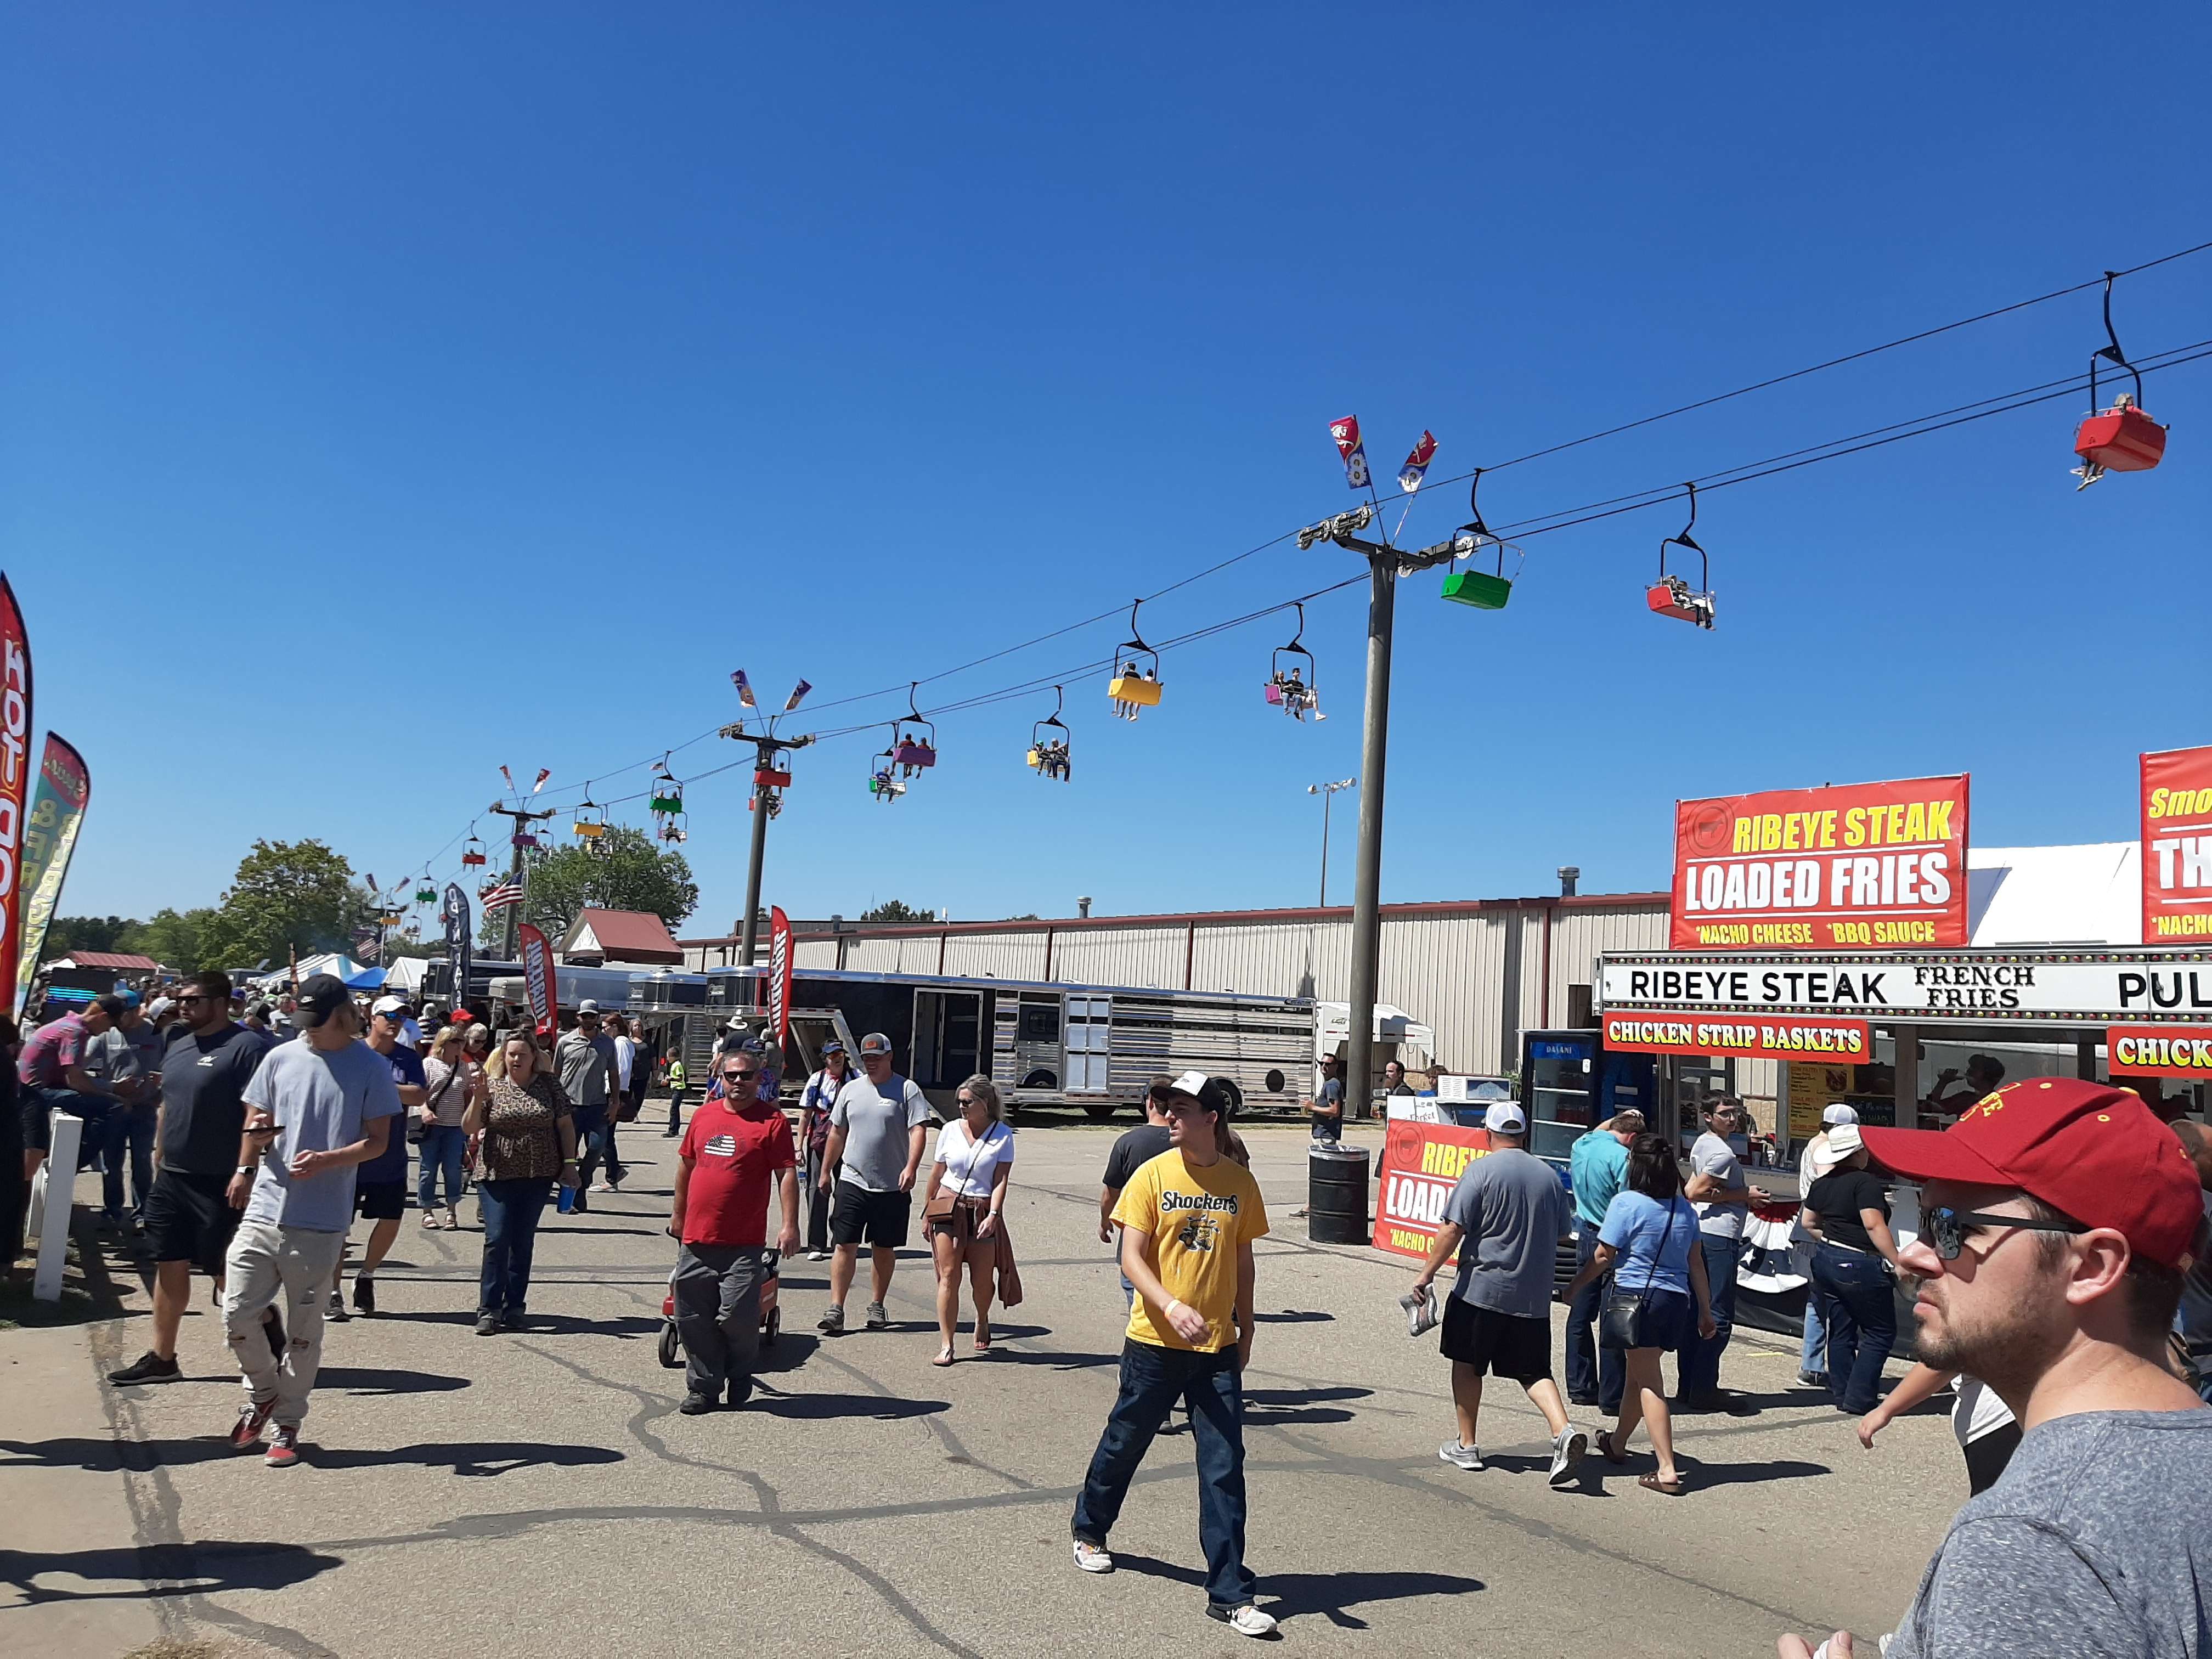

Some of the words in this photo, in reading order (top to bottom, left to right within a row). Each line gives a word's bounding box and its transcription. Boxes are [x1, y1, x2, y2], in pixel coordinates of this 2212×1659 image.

[1733, 810, 1838, 853] RIBEYE
[1845, 801, 1955, 845] STEAK
[1685, 861, 1820, 911] LOADED
[1831, 851, 1951, 906] FRIES
[1752, 923, 1814, 944] CHEESE
[1874, 921, 1936, 943] SAUCE
[1631, 971, 1749, 1002] RIBEYE
[1762, 973, 1888, 1004] STEAK
[1914, 967, 2035, 987] FRENCH
[1927, 988, 2019, 1008] FRIES
[1546, 1045, 1572, 1054] DASANI
[1608, 1020, 1692, 1045] CHICKEN
[1697, 1023, 1756, 1048] STRIP
[1761, 1026, 1863, 1053] BASKETS
[2116, 1037, 2212, 1068] CHICK
[1161, 1191, 1238, 1215] Shockers
